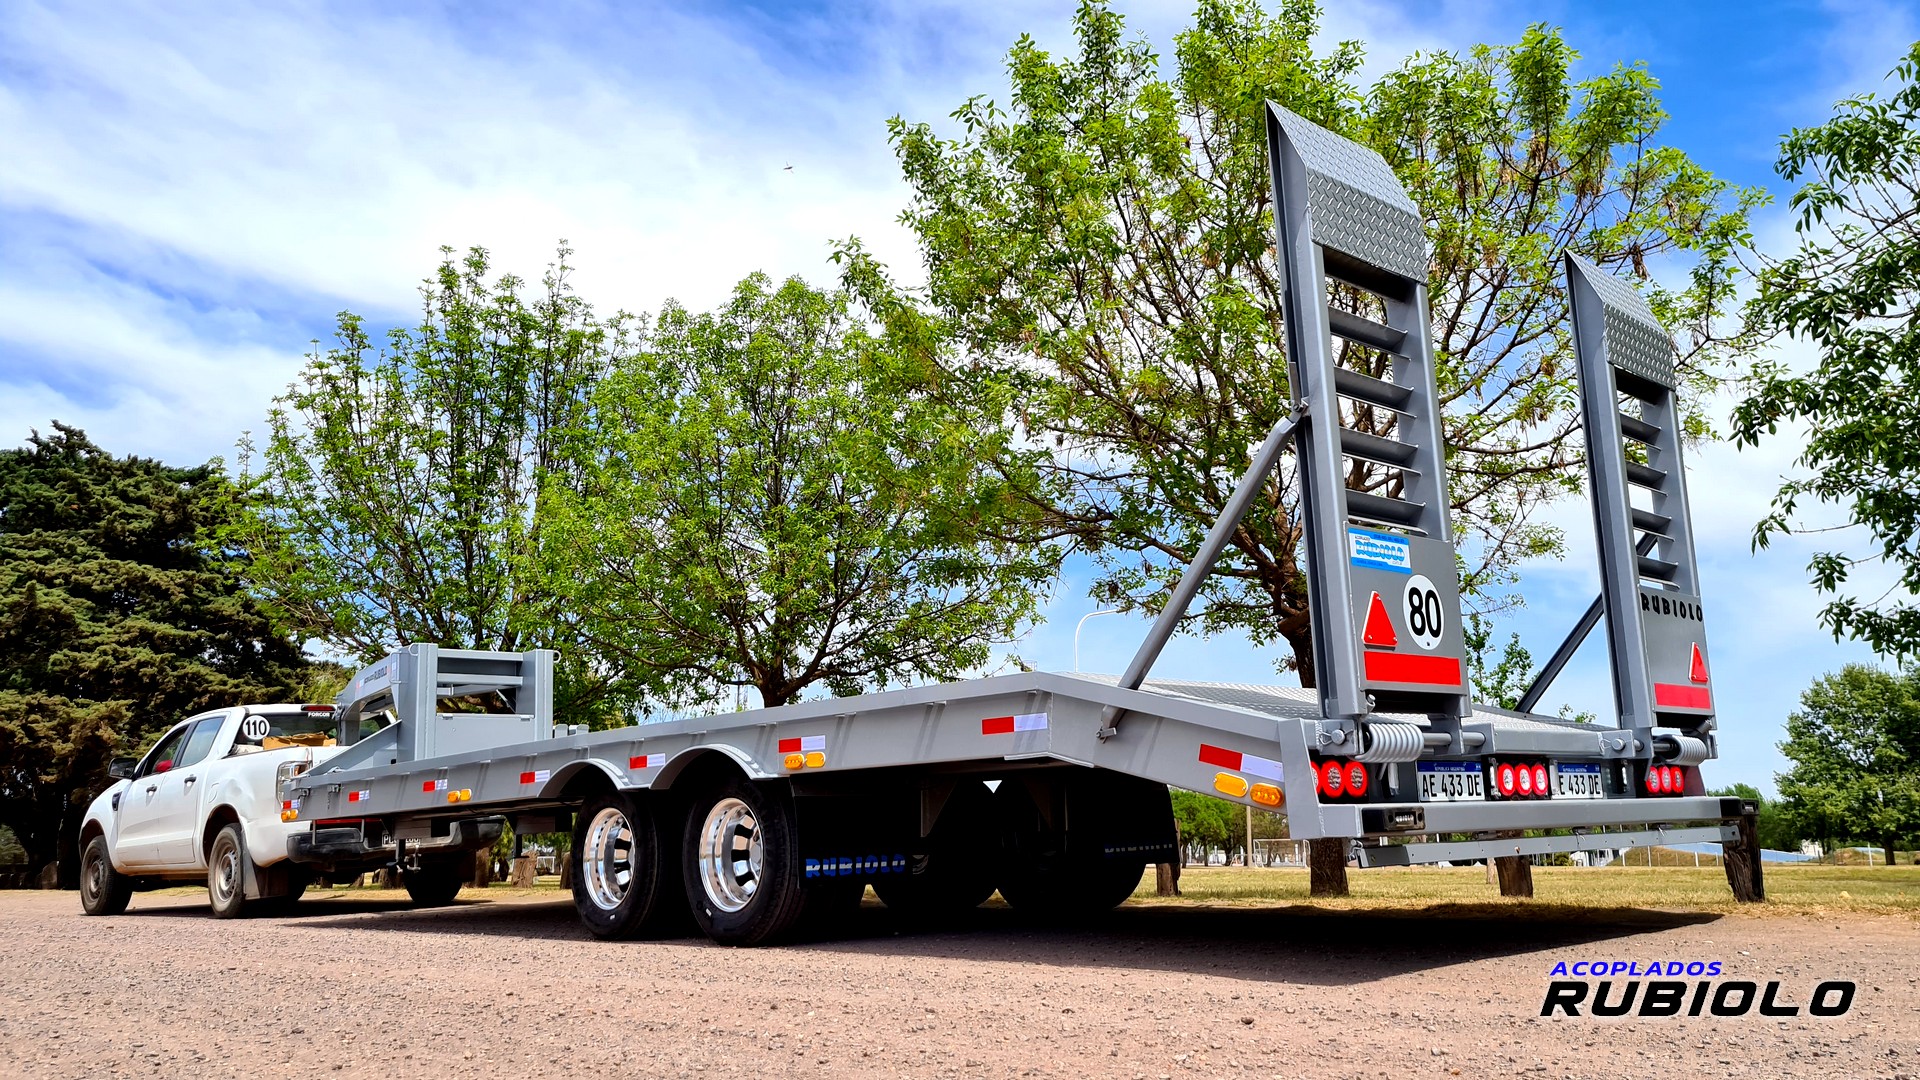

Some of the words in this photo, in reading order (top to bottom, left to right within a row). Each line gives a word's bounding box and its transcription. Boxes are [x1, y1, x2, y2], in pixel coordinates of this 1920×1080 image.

[1355, 540, 1405, 562] RUBIOLO
[1408, 587, 1442, 638] 80
[1640, 592, 1703, 622] RUBIOLO
[246, 720, 267, 736] 110
[1422, 774, 1438, 797] AE
[1441, 774, 1464, 797] 433
[1466, 774, 1482, 796] DE
[1568, 775, 1586, 795] 433
[1588, 775, 1601, 795] DE
[805, 853, 906, 878] RUBIOLO
